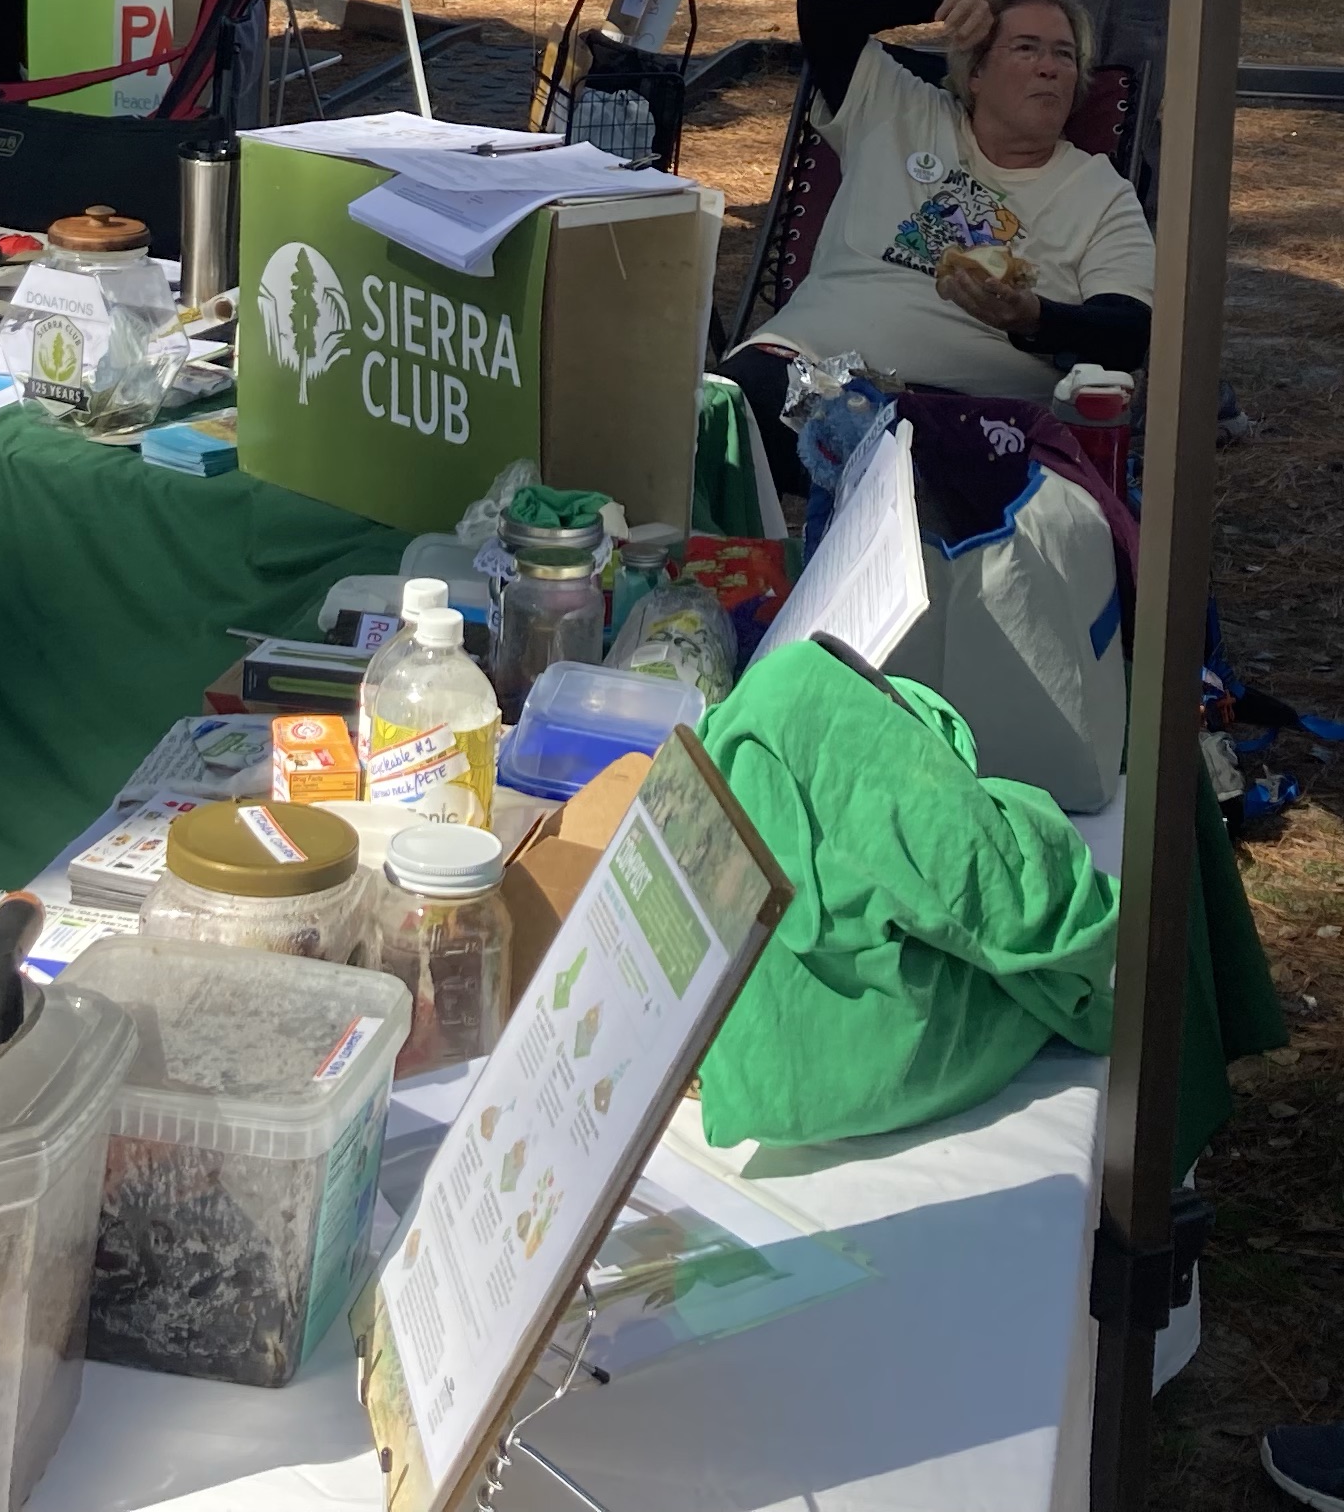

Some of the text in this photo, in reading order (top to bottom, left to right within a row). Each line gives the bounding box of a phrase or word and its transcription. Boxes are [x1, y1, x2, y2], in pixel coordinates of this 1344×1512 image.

[114, 90, 151, 110] Peace
[26, 290, 94, 317] DONATIONS
[36, 318, 82, 346] SIERRA CLUB
[361, 273, 522, 388] SIERRA
[30, 380, 82, 403] 125 YEARS
[361, 349, 470, 445] CLUB
[370, 748, 415, 776] ecyclable
